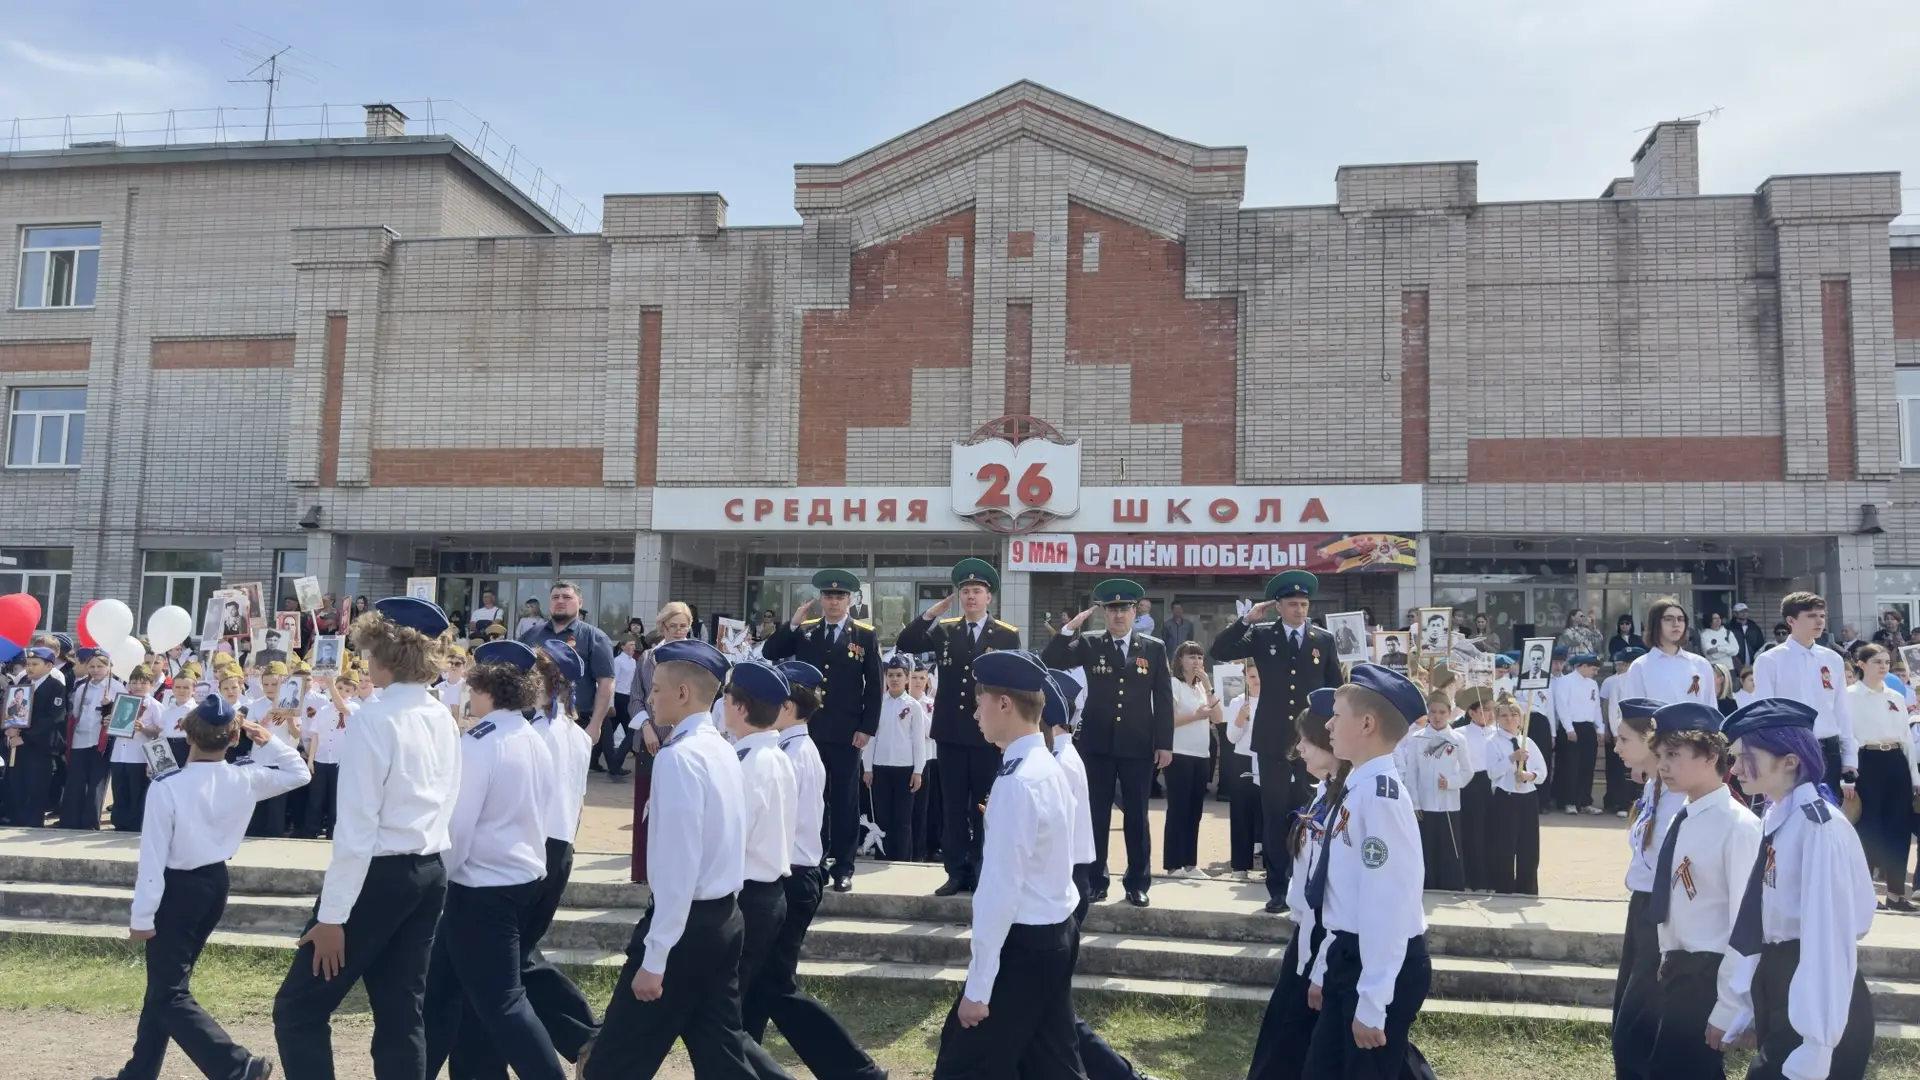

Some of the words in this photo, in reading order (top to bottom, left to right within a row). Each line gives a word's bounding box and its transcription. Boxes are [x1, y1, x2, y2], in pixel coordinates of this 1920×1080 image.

[976, 463, 1053, 506] 26
[724, 498, 928, 525] СРЕДНЯЯ
[1113, 498, 1329, 523] ШКОЛА
[1012, 540, 1024, 563] 9
[1028, 541, 1068, 564] МАЯ
[1083, 543, 1100, 566] С
[1105, 540, 1178, 570] ДНЁМ
[1184, 543, 1307, 571] ПОБЕДЫ!
